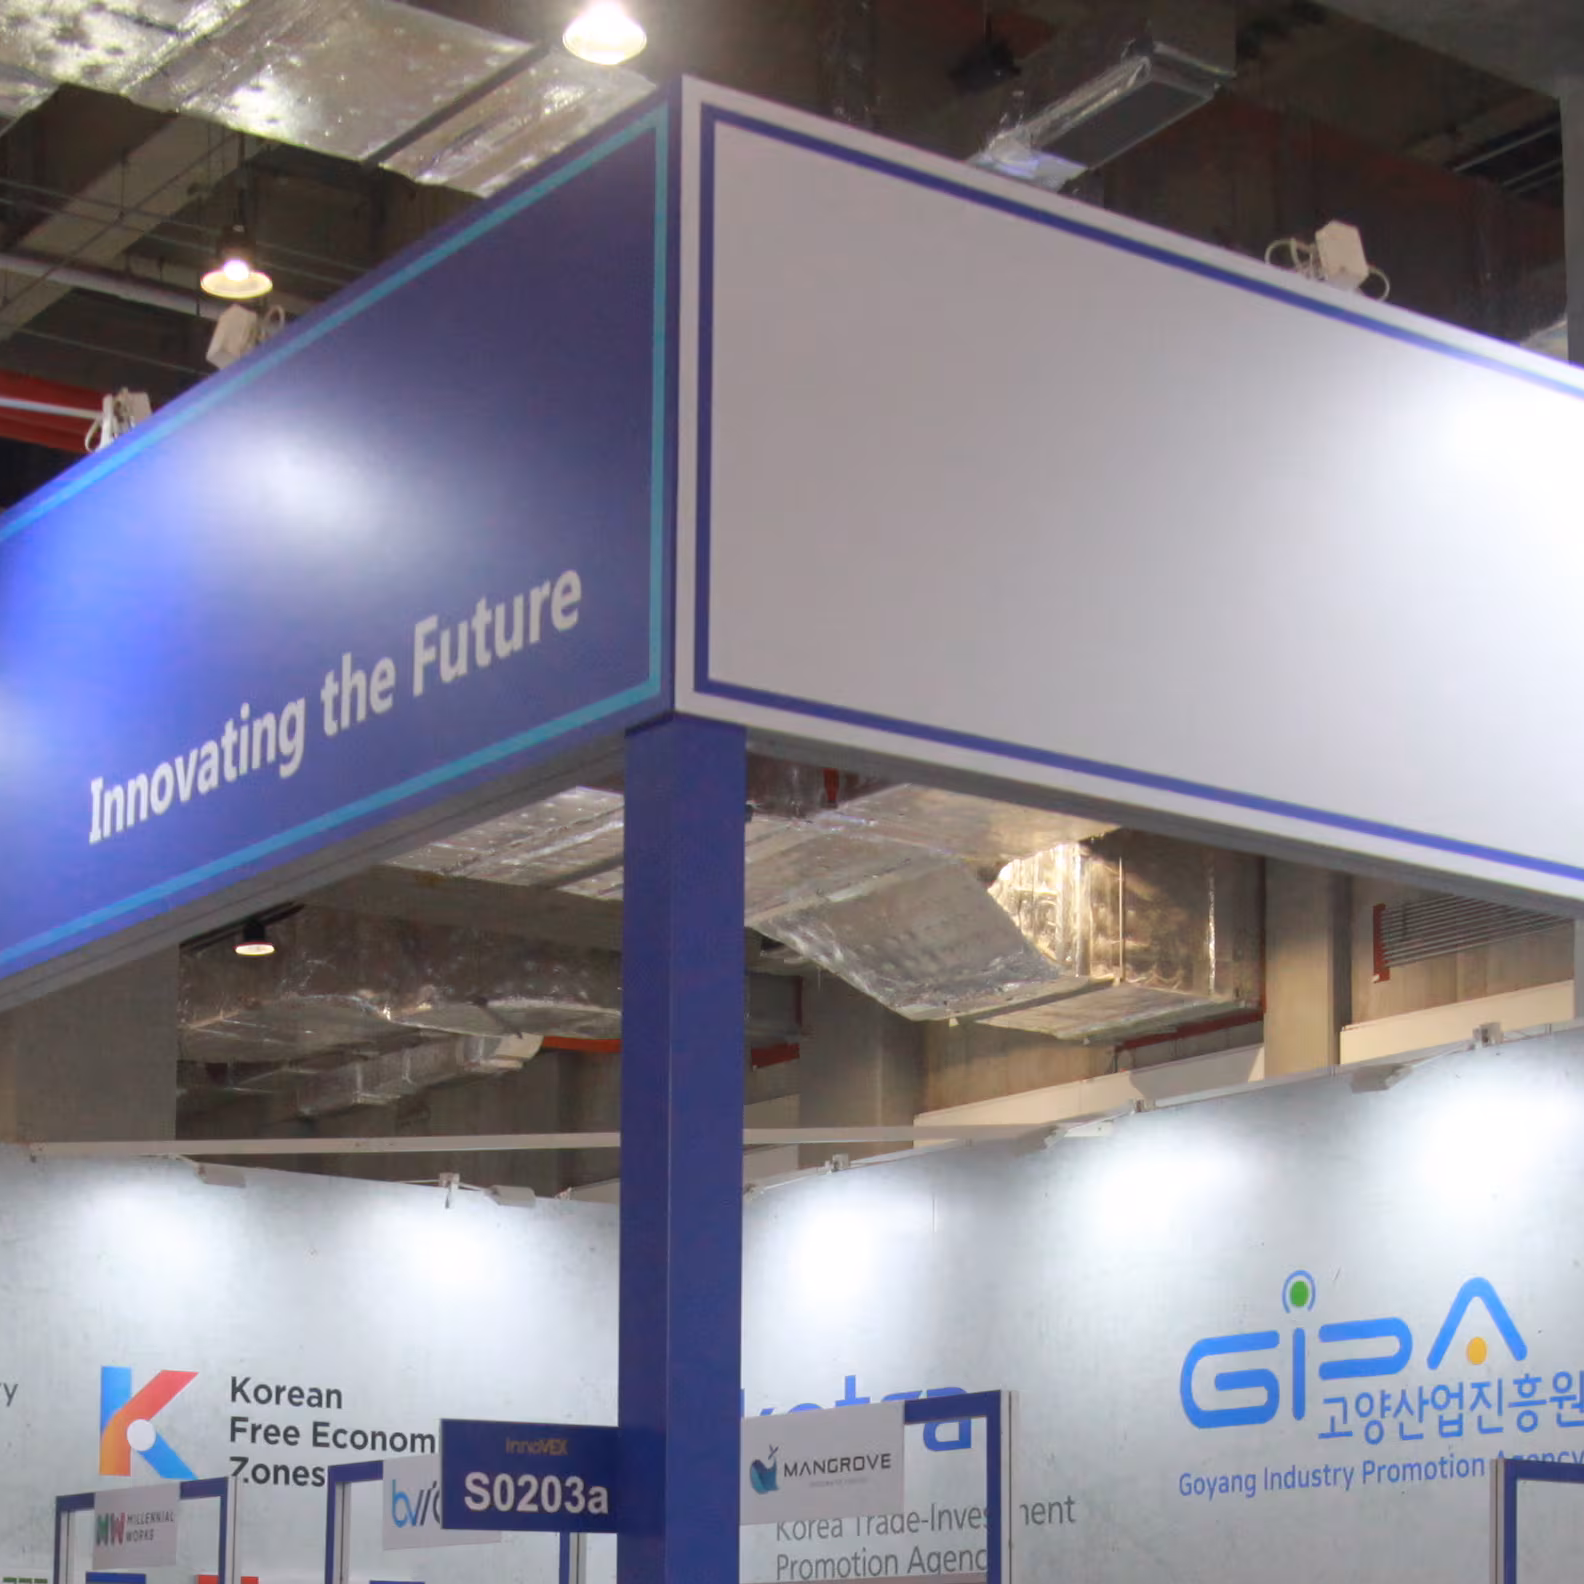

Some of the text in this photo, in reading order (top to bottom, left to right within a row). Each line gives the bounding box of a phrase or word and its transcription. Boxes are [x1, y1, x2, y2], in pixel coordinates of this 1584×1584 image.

[89, 568, 583, 845] Innovating the Future
[229, 1375, 343, 1409] Korean
[229, 1415, 437, 1453] Free Econom
[229, 1455, 326, 1488] Zones
[783, 1452, 892, 1479] MANGROVE
[1178, 1472, 1257, 1501] Goyang
[1263, 1463, 1355, 1491] Industry
[1362, 1453, 1486, 1485] Promotion
[464, 1470, 609, 1515] S0203a
[126, 1510, 176, 1525] MILLENNIAL
[125, 1528, 155, 1543] WORKS
[776, 1545, 988, 1581] Promotion Agenc
